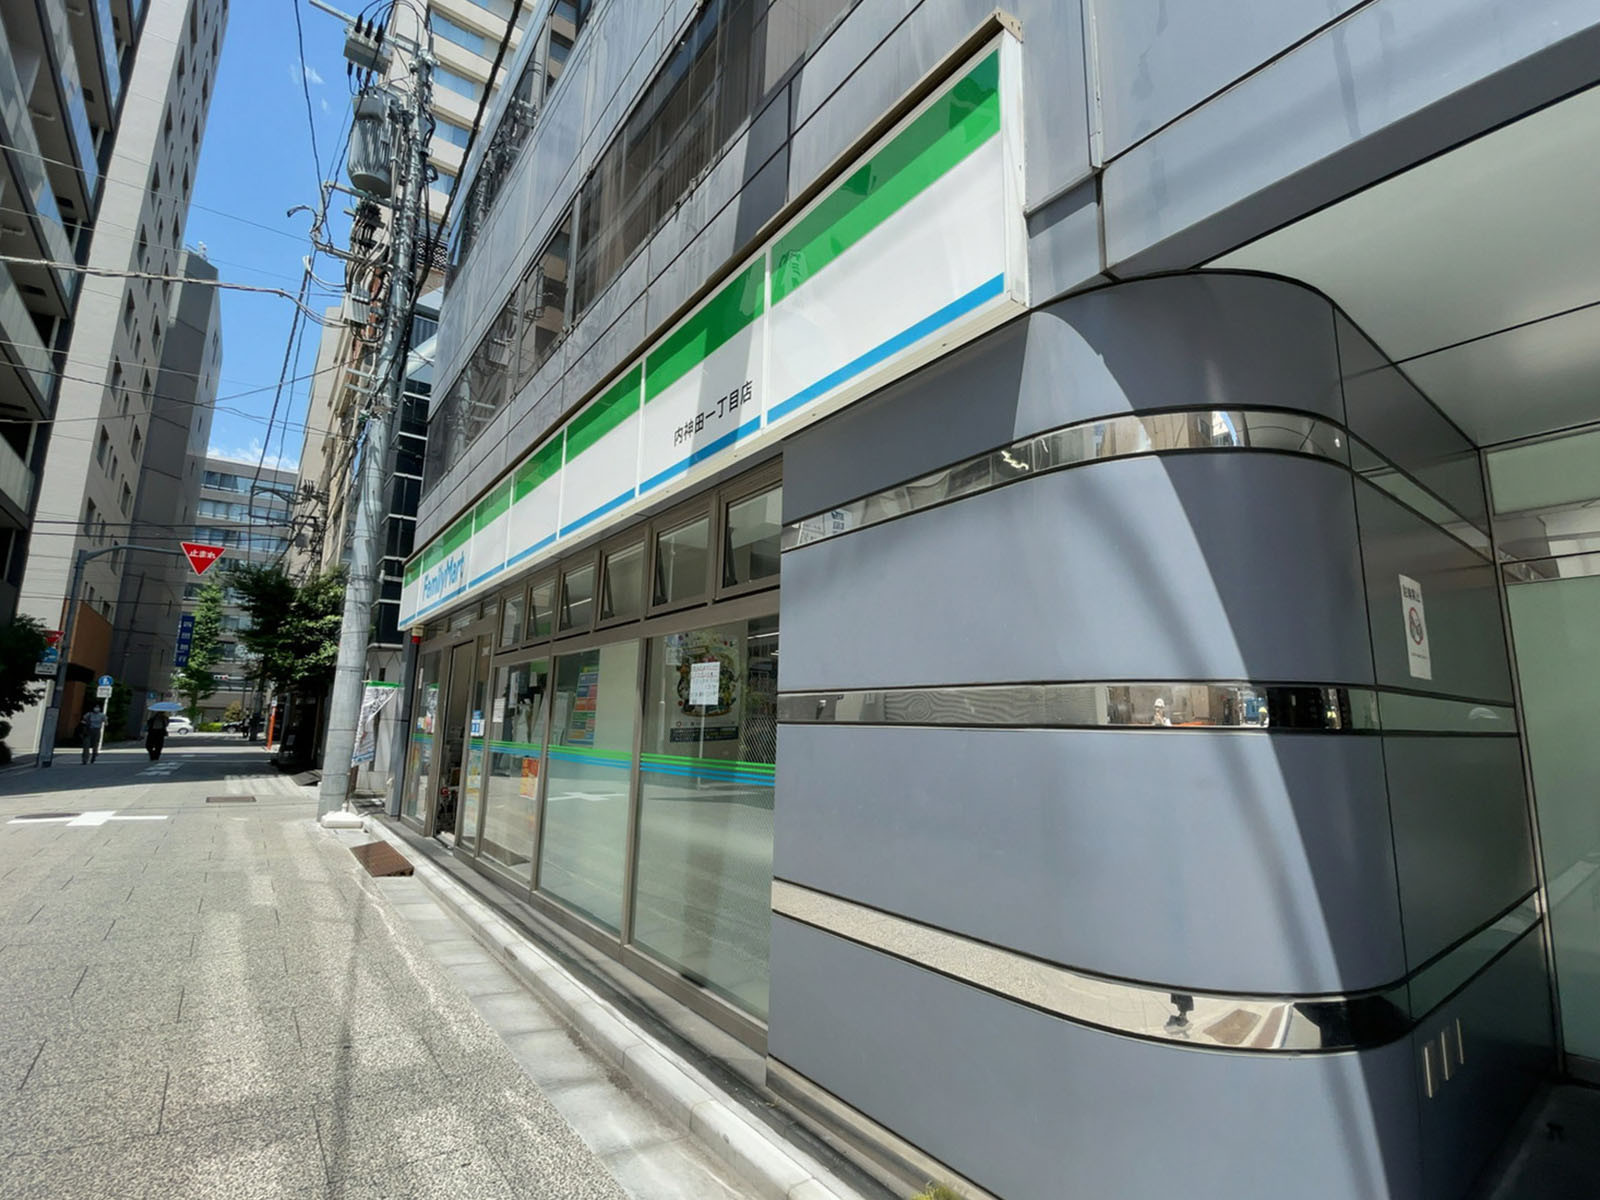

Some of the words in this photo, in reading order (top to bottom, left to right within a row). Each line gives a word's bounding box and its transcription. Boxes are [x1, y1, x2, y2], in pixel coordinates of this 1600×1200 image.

[673, 380, 753, 447] 内神田一丁目店
[189, 548, 216, 559] 止まれ
[423, 550, 465, 598] FamilyMart
